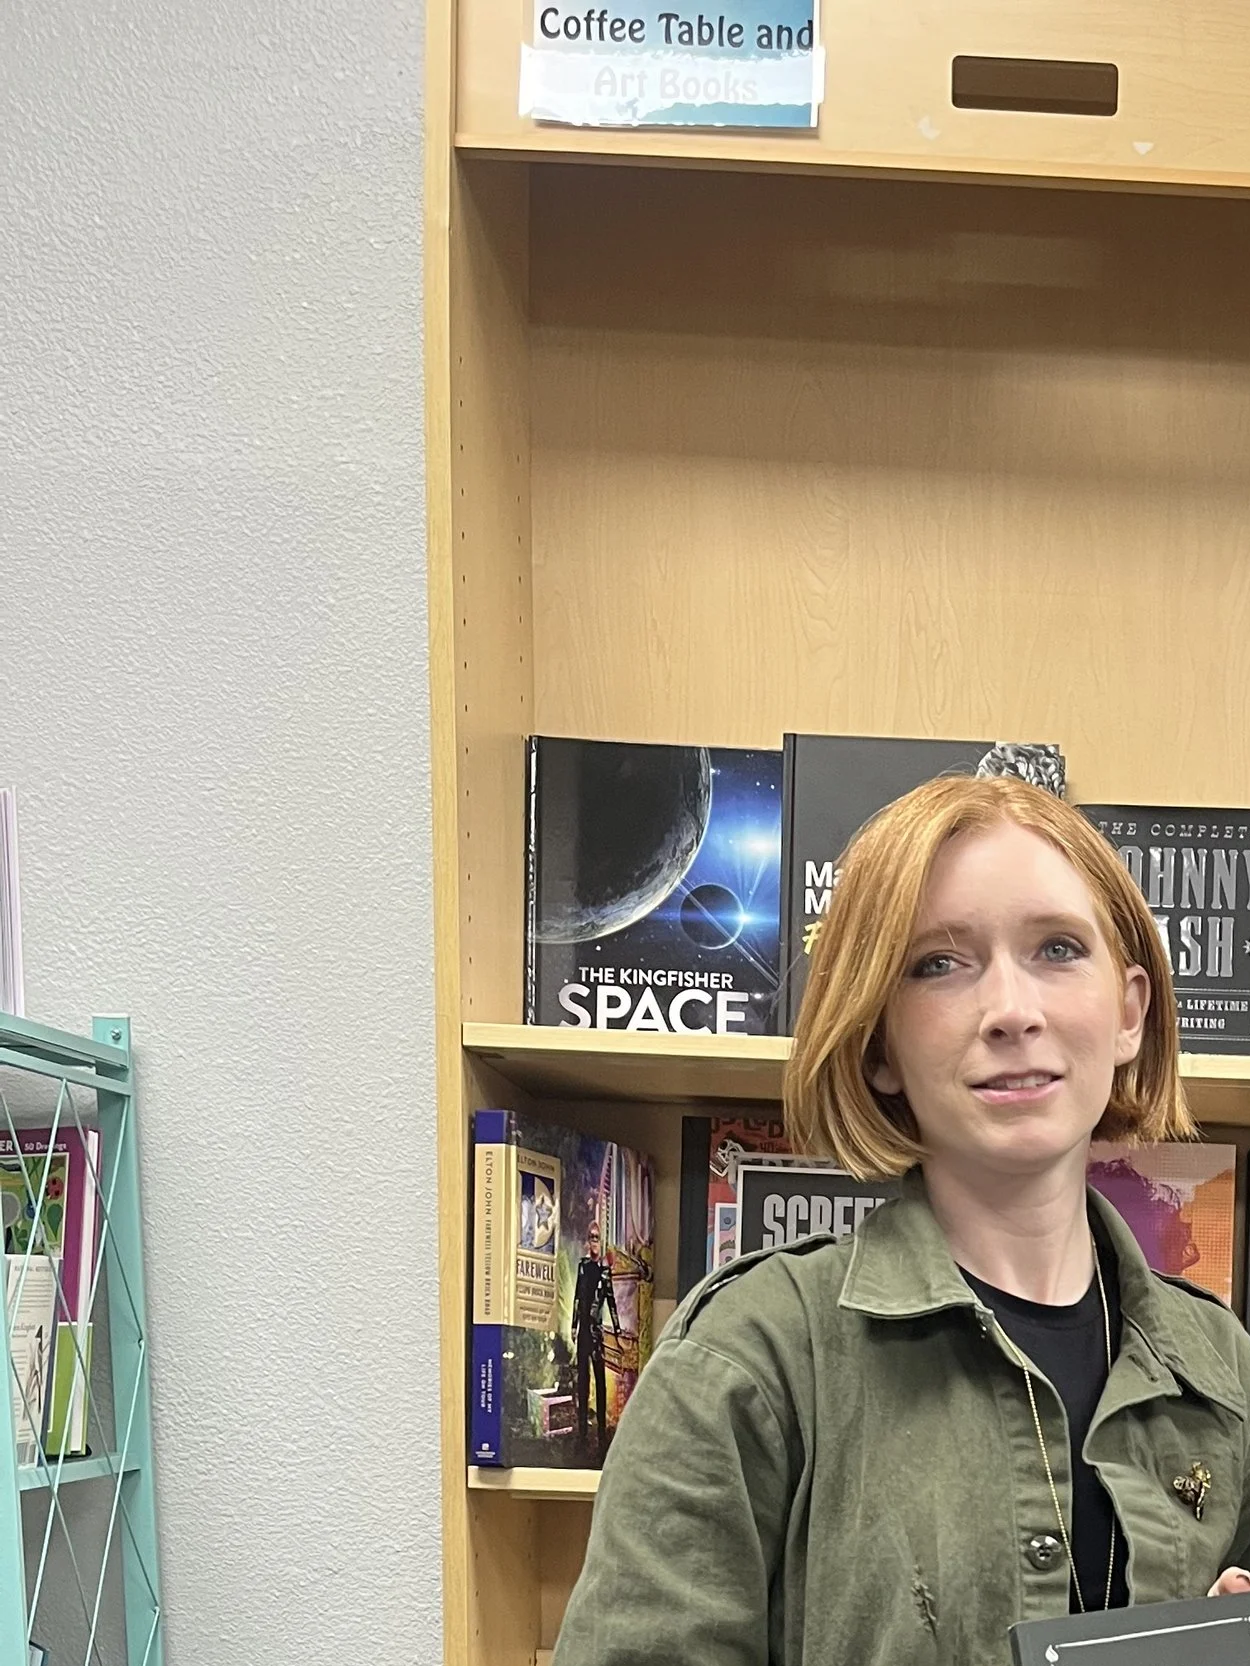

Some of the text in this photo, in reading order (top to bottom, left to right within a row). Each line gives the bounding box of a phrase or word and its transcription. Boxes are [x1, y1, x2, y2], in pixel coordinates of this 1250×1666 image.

[539, 7, 814, 51] Coffee Table and
[594, 66, 758, 102] Art Books
[1099, 822, 1138, 836] THE
[578, 966, 734, 989] THE KINGFISHER
[557, 983, 749, 1036] SPACE
[1187, 999, 1249, 1011] LIFETIME
[484, 1151, 494, 1215] ELTON JOHN
[763, 1194, 886, 1250] SCREE
[517, 1258, 555, 1283] FAREWELL
